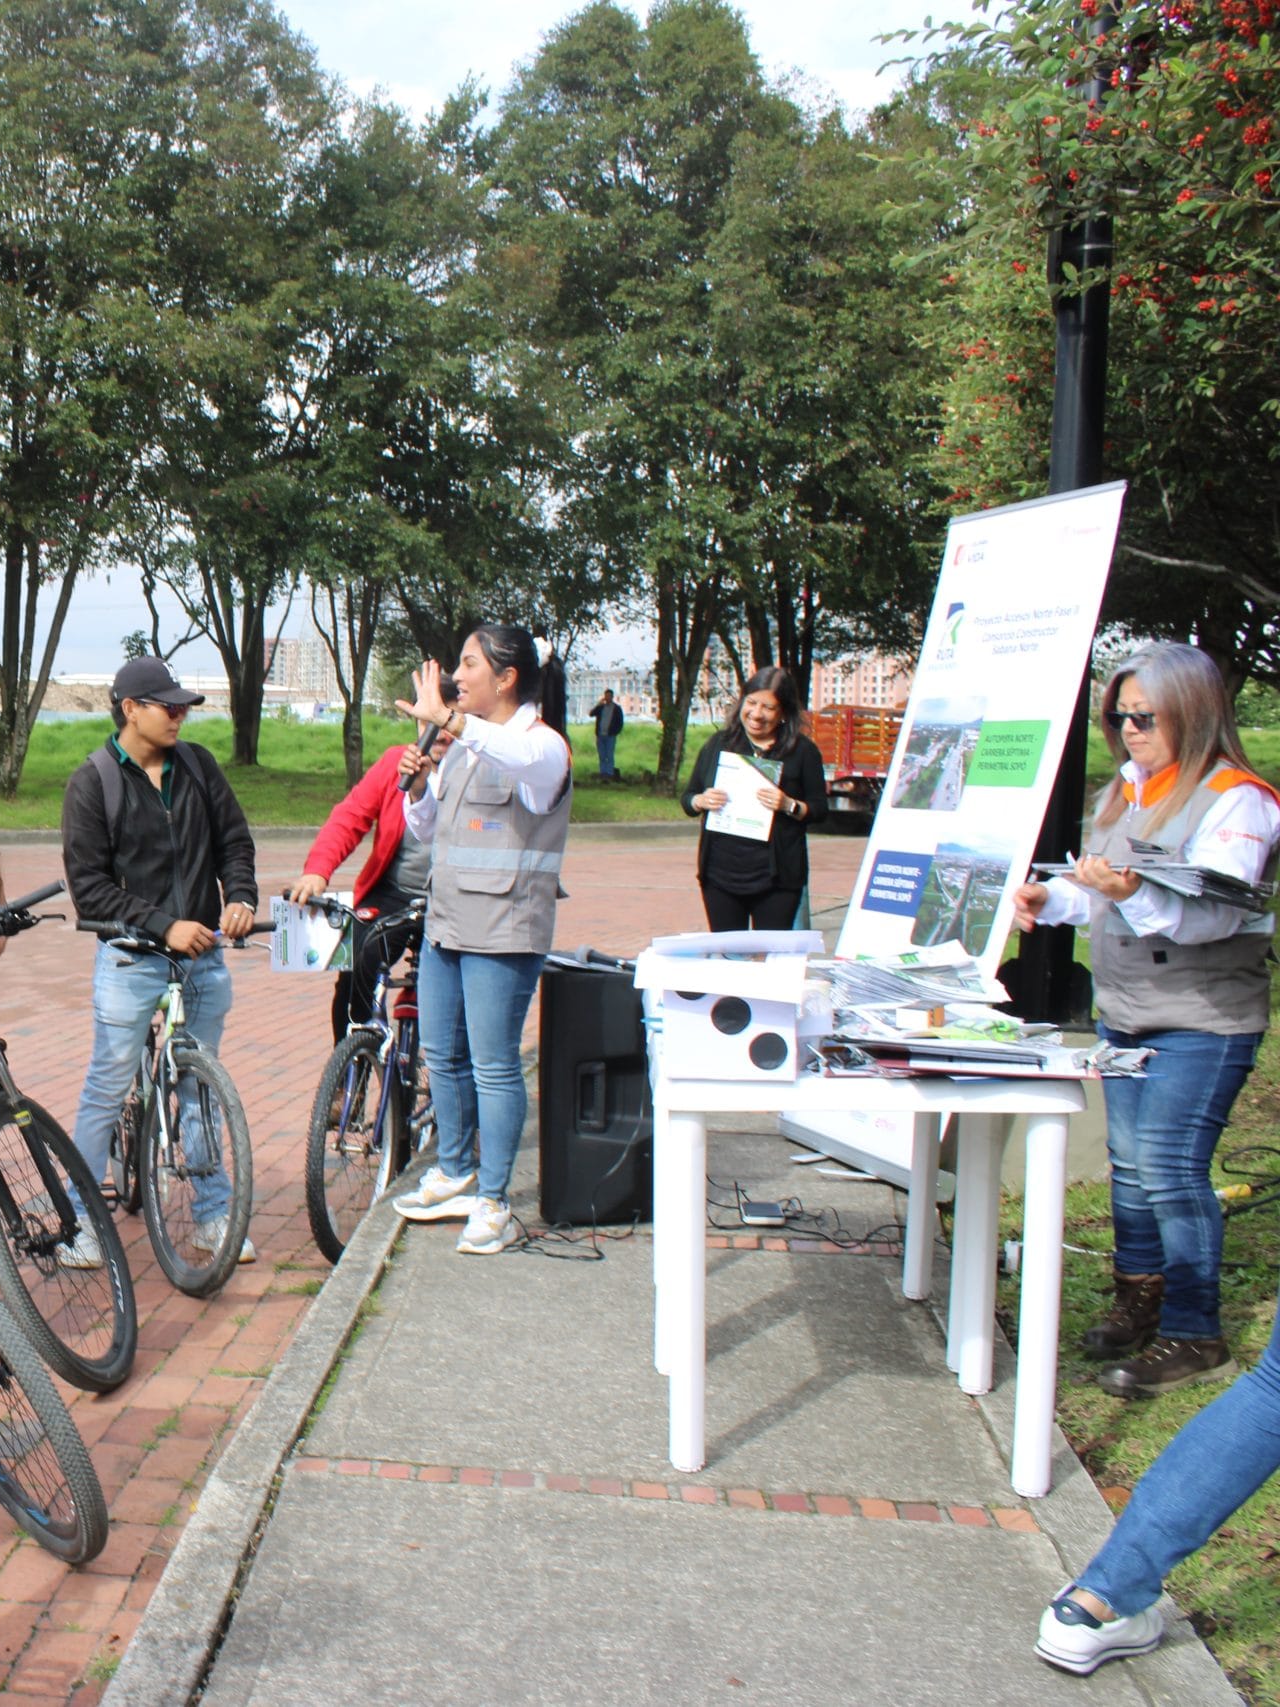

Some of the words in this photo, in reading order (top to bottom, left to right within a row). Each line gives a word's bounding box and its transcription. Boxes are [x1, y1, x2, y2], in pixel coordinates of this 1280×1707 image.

[974, 614, 1002, 626] Proyecto
[1005, 612, 1030, 622] Accesos
[1033, 608, 1053, 618] Norte
[1055, 606, 1072, 616] Fase
[982, 631, 1015, 642] Consorcio
[1016, 626, 1060, 639] Constructor
[992, 644, 1017, 655] Sabana
[1019, 642, 1039, 653] Norte
[986, 734, 1014, 743] AUTOPISTA
[1016, 734, 1034, 743] NORTE
[981, 748, 1005, 756] CARRERA
[978, 762, 1009, 770] PERIMETRAL
[877, 864, 901, 874] AUTOPISTA
[873, 876, 893, 886] CARRERA
[870, 889, 897, 900] PERIMETRAL
